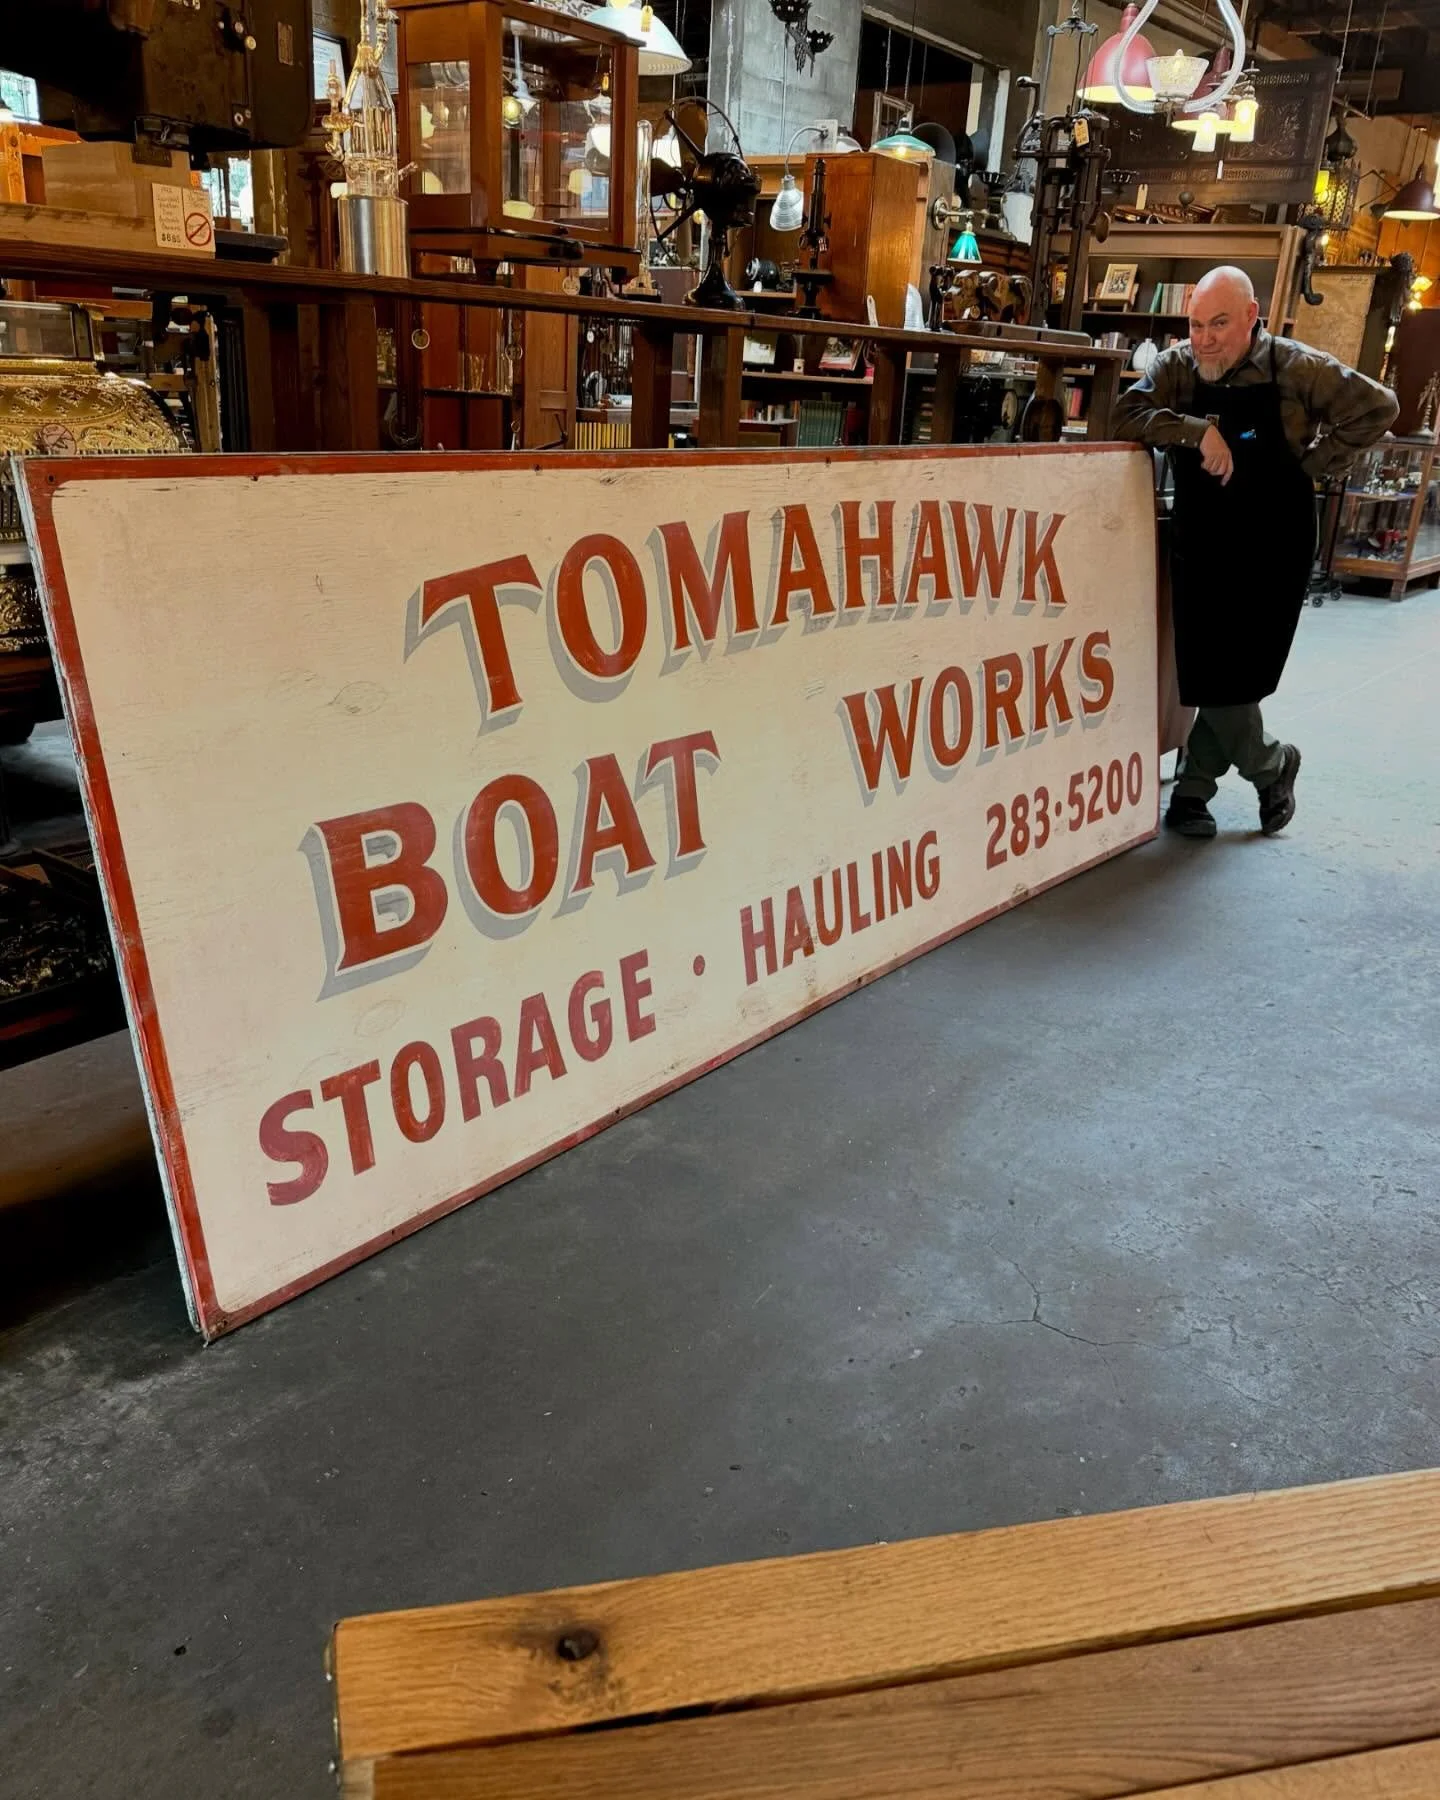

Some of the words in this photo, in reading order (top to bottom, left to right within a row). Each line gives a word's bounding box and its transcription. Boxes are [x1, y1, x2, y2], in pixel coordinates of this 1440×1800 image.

[405, 498, 1068, 732] TOMAHAWK
[303, 730, 721, 996] BOAT
[836, 630, 1115, 805] WORKS
[259, 948, 656, 1206] STORAGE
[740, 830, 941, 985] HAULING
